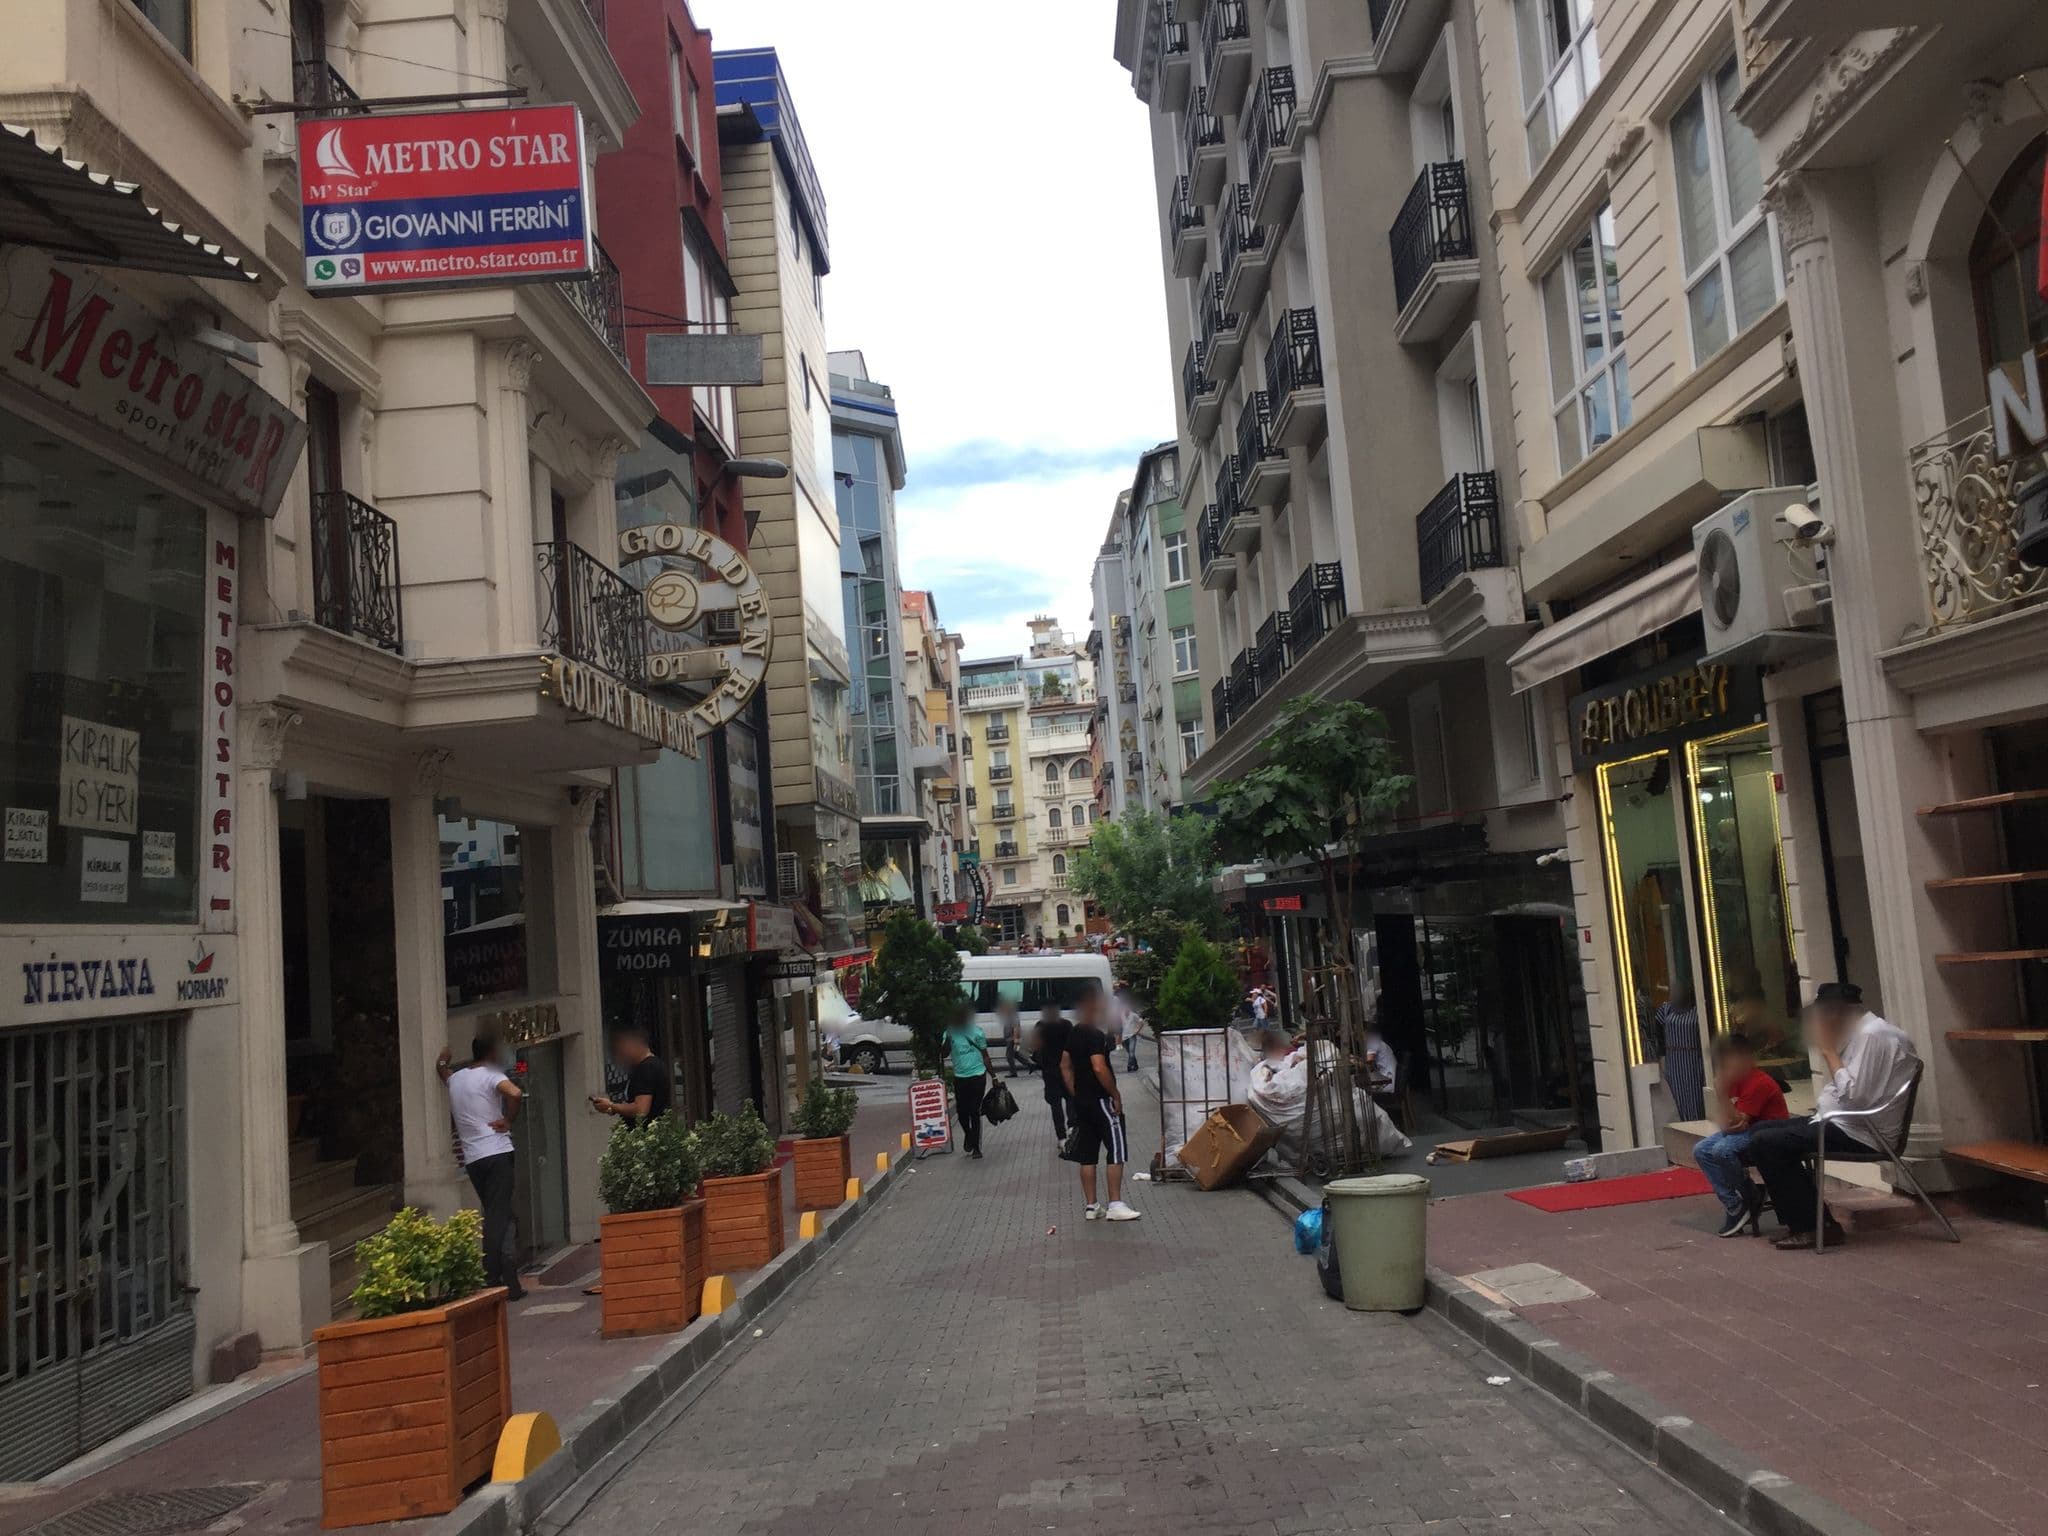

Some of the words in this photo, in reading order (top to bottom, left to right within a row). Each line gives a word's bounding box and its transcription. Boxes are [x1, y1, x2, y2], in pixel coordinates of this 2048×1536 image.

[365, 138, 481, 175] METRO
[489, 133, 571, 168] STAR
[365, 210, 484, 240] GIOVANNI
[370, 247, 577, 276] www.metro.star.com.tr
[14, 268, 203, 422] Metro
[115, 400, 178, 442] sport
[619, 525, 768, 659] GOLDEN
[559, 657, 626, 729] GOLDEN
[606, 925, 682, 948] ZÜMRA
[23, 951, 155, 1004] NİRVANA
[616, 953, 672, 970] MODA
